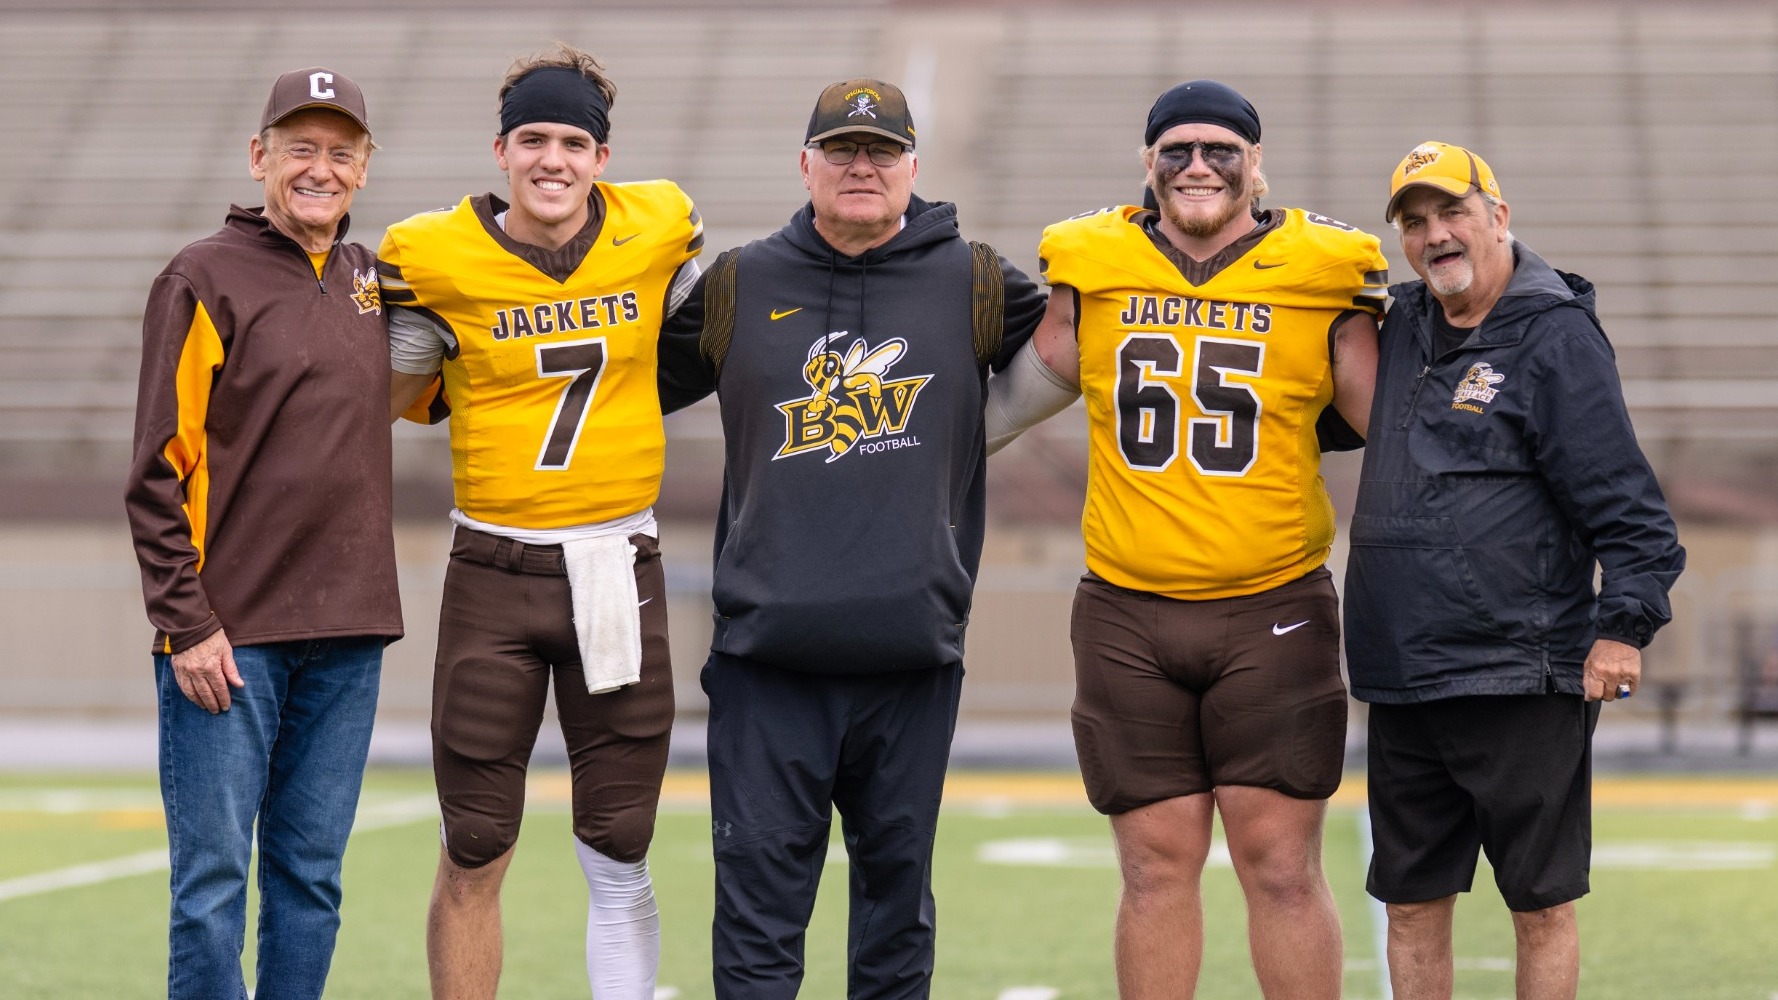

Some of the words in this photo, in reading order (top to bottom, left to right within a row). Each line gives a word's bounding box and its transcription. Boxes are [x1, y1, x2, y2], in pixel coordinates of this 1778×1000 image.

[309, 72, 335, 99] C
[492, 291, 640, 341] JACKETS
[1120, 296, 1272, 334] JACKETS
[533, 336, 608, 471] 7
[1113, 332, 1266, 477] 65
[1451, 403, 1484, 414] FOOTBALL
[859, 436, 921, 455] FOOTBALL
